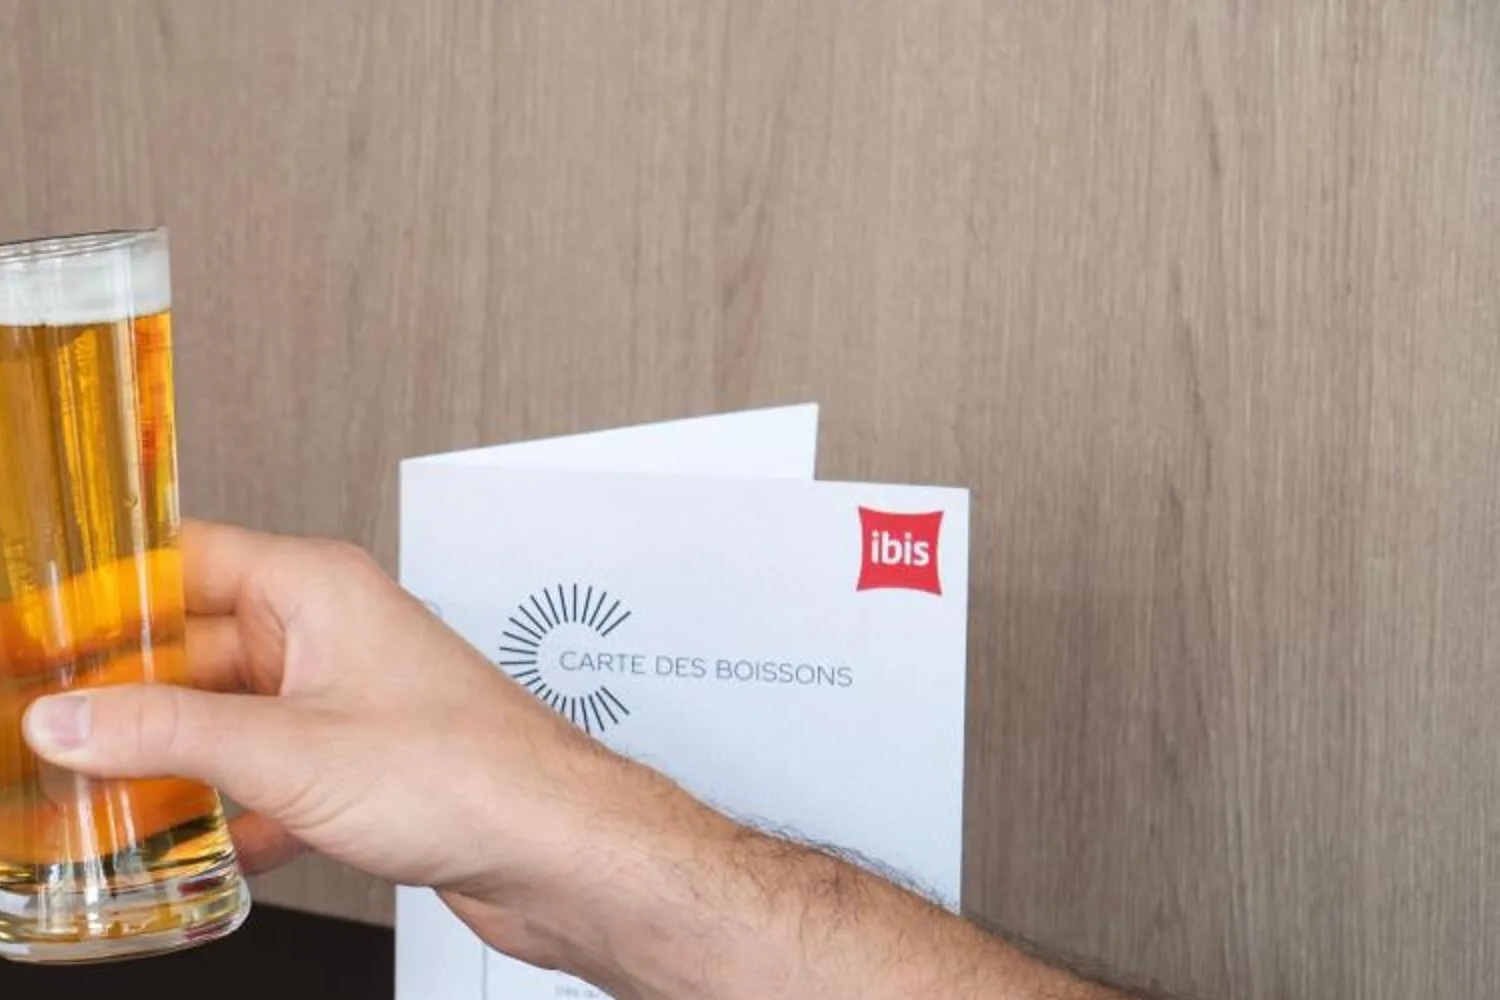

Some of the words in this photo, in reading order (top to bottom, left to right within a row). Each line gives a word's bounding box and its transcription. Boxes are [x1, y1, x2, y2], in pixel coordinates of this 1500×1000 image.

[871, 530, 930, 567] ibis
[559, 650, 645, 675] CARTE
[655, 656, 707, 679] DES
[716, 659, 853, 687] BOISSONS
